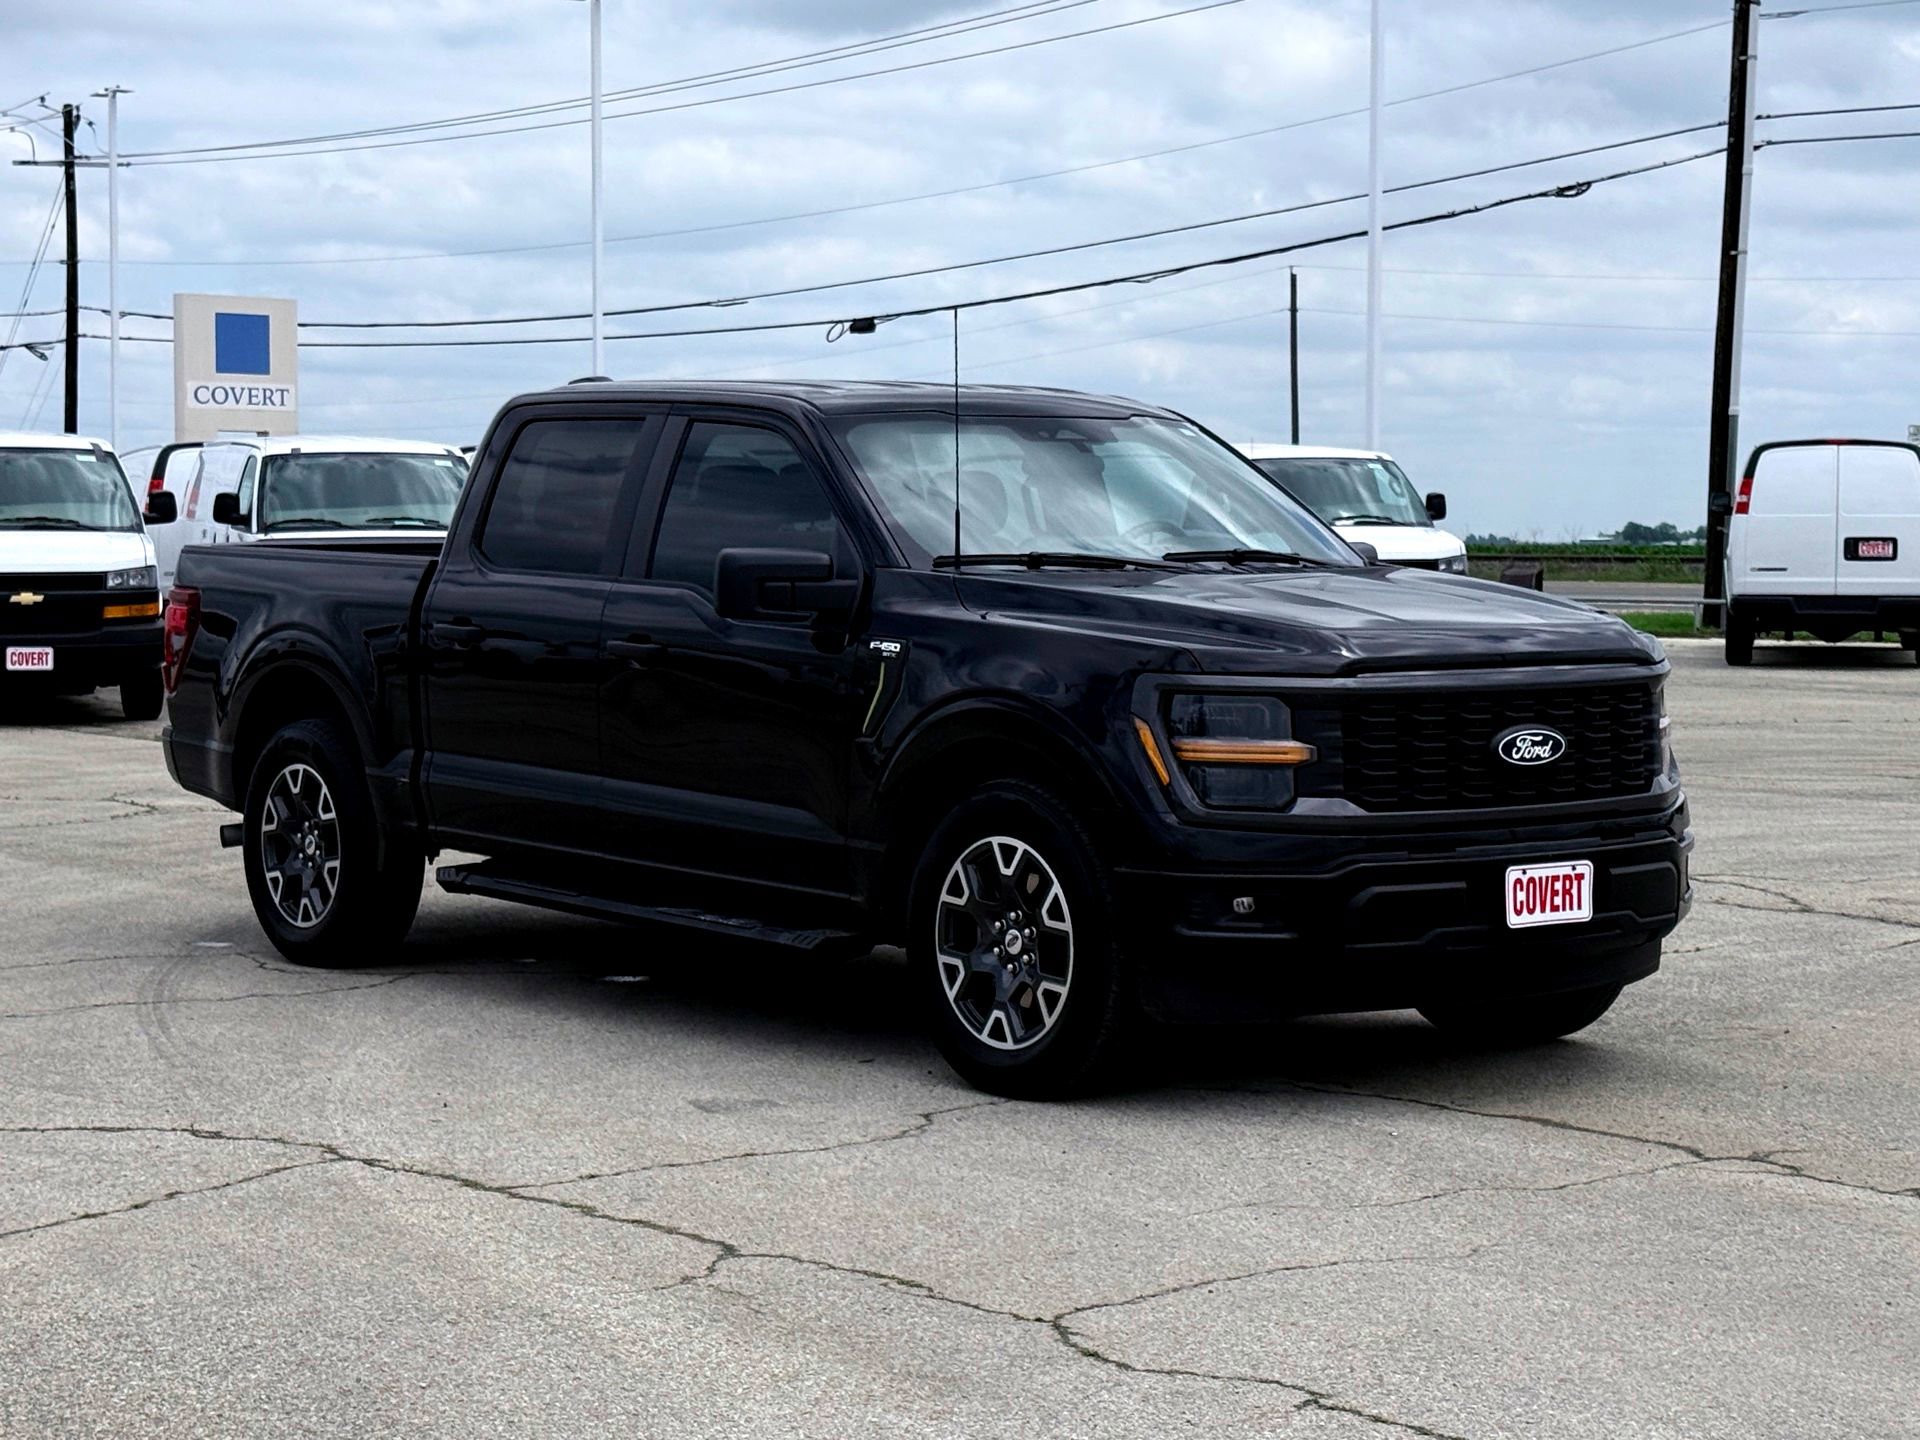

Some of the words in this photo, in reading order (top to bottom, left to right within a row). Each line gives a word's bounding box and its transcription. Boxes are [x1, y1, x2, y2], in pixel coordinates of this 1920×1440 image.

[193, 385, 290, 406] COVERT
[10, 651, 50, 667] COVERT
[1512, 735, 1553, 759] Ford
[1513, 873, 1585, 917] COVERT
